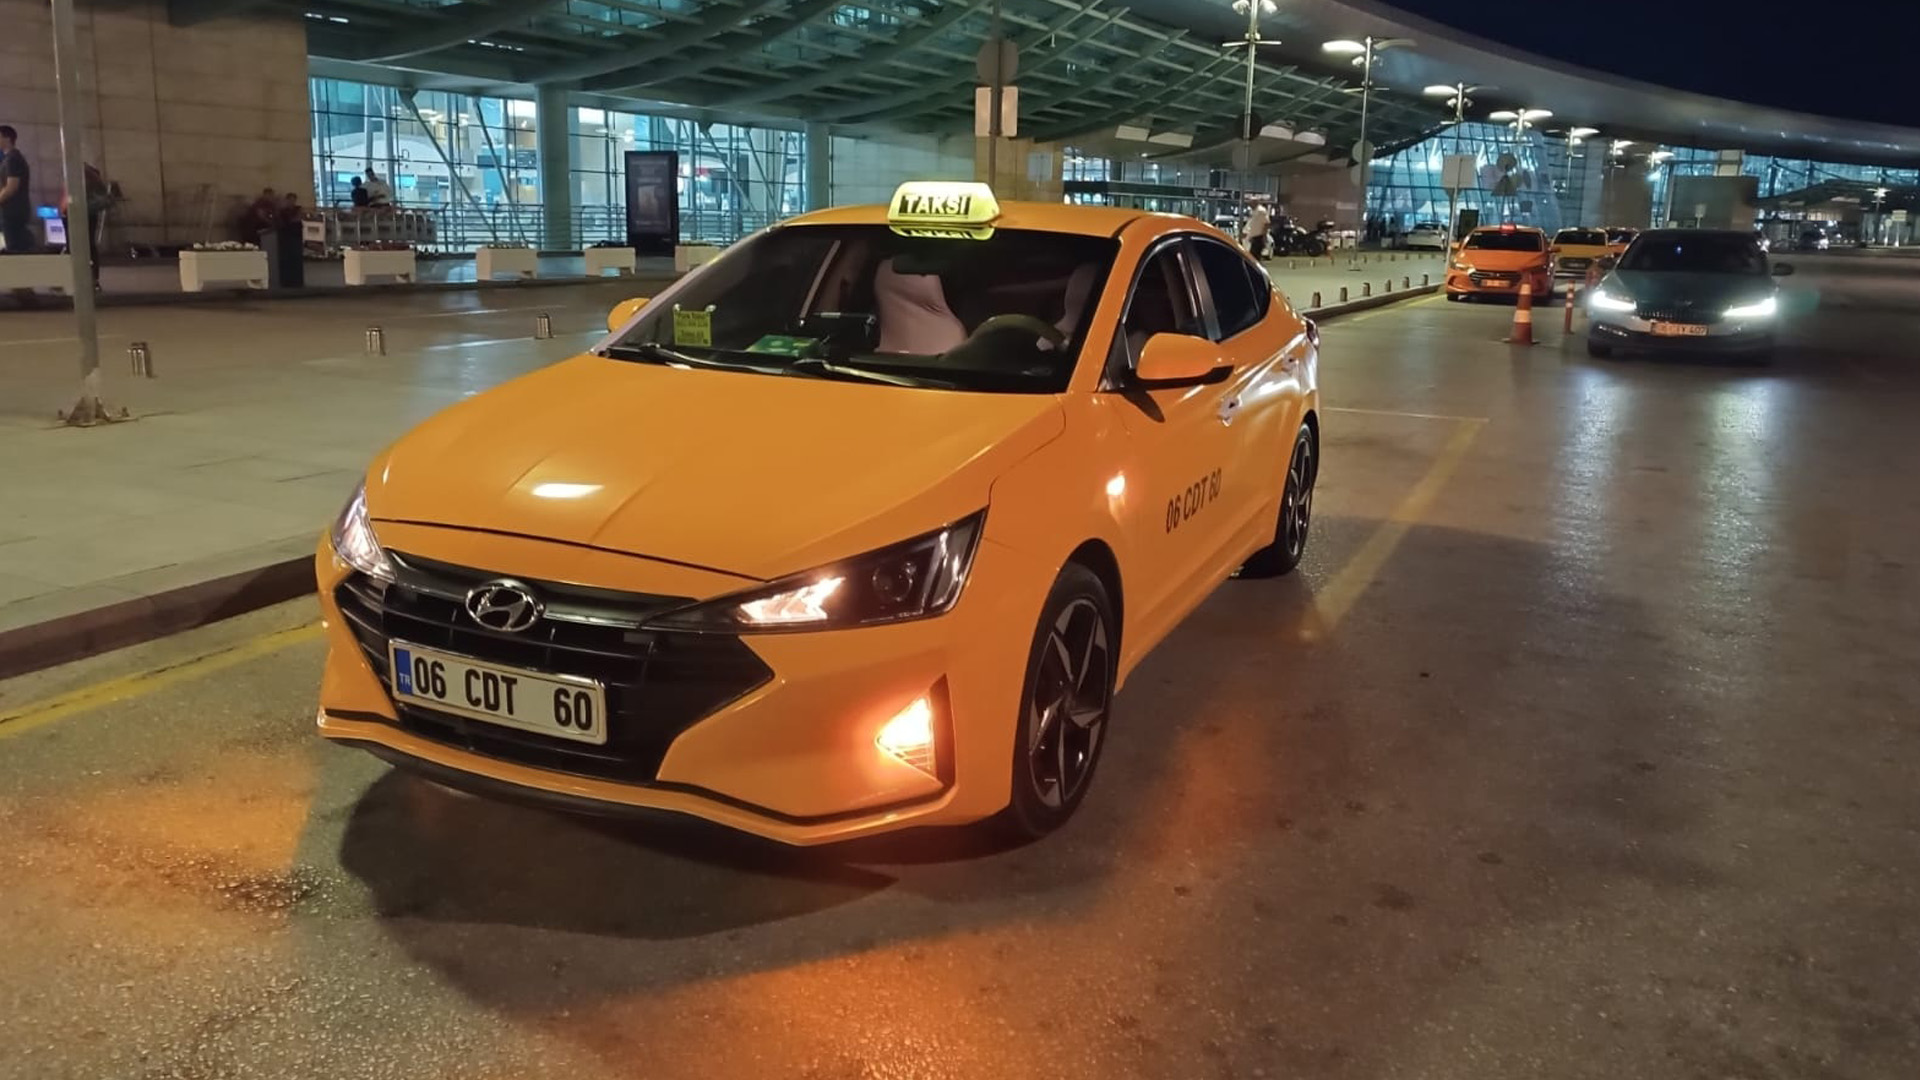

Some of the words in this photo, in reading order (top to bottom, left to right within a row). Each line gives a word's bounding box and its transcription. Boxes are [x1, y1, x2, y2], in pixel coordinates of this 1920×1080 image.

[904, 194, 968, 215] TAKSI
[1166, 494, 1181, 534] 06
[1183, 475, 1208, 520] CDT
[1209, 467, 1222, 503] 60
[400, 673, 411, 686] TR
[414, 656, 447, 700] 06
[465, 668, 518, 716] CDT
[553, 687, 592, 731] 60
